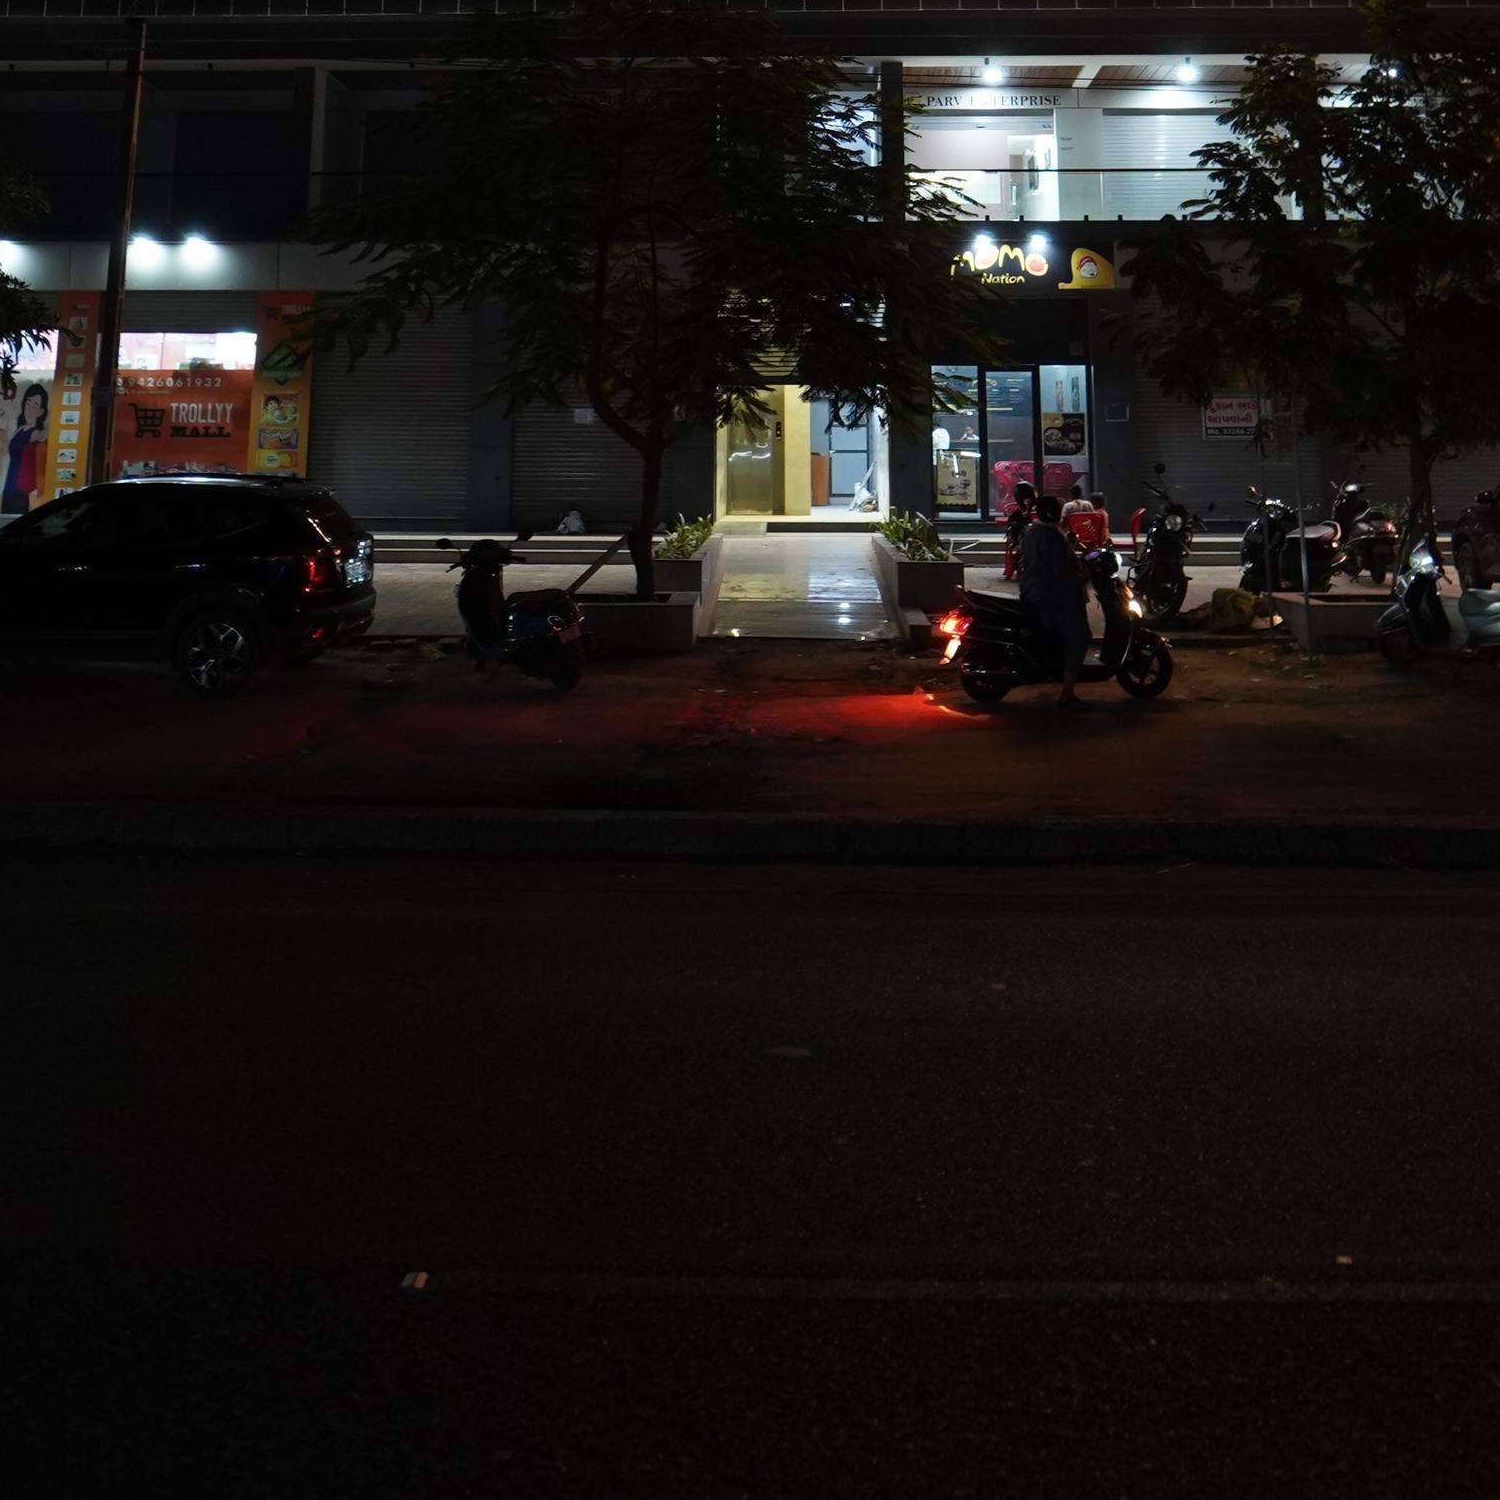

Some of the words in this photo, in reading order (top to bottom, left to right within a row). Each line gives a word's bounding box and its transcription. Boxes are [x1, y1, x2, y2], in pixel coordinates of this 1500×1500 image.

[927, 95, 962, 107] PARV
[970, 94, 1061, 107] ERPRISE
[980, 272, 1026, 285] Nation
[128, 376, 222, 388] 9426061932
[170, 402, 233, 423] TROLLYY
[169, 426, 232, 438] MALL
